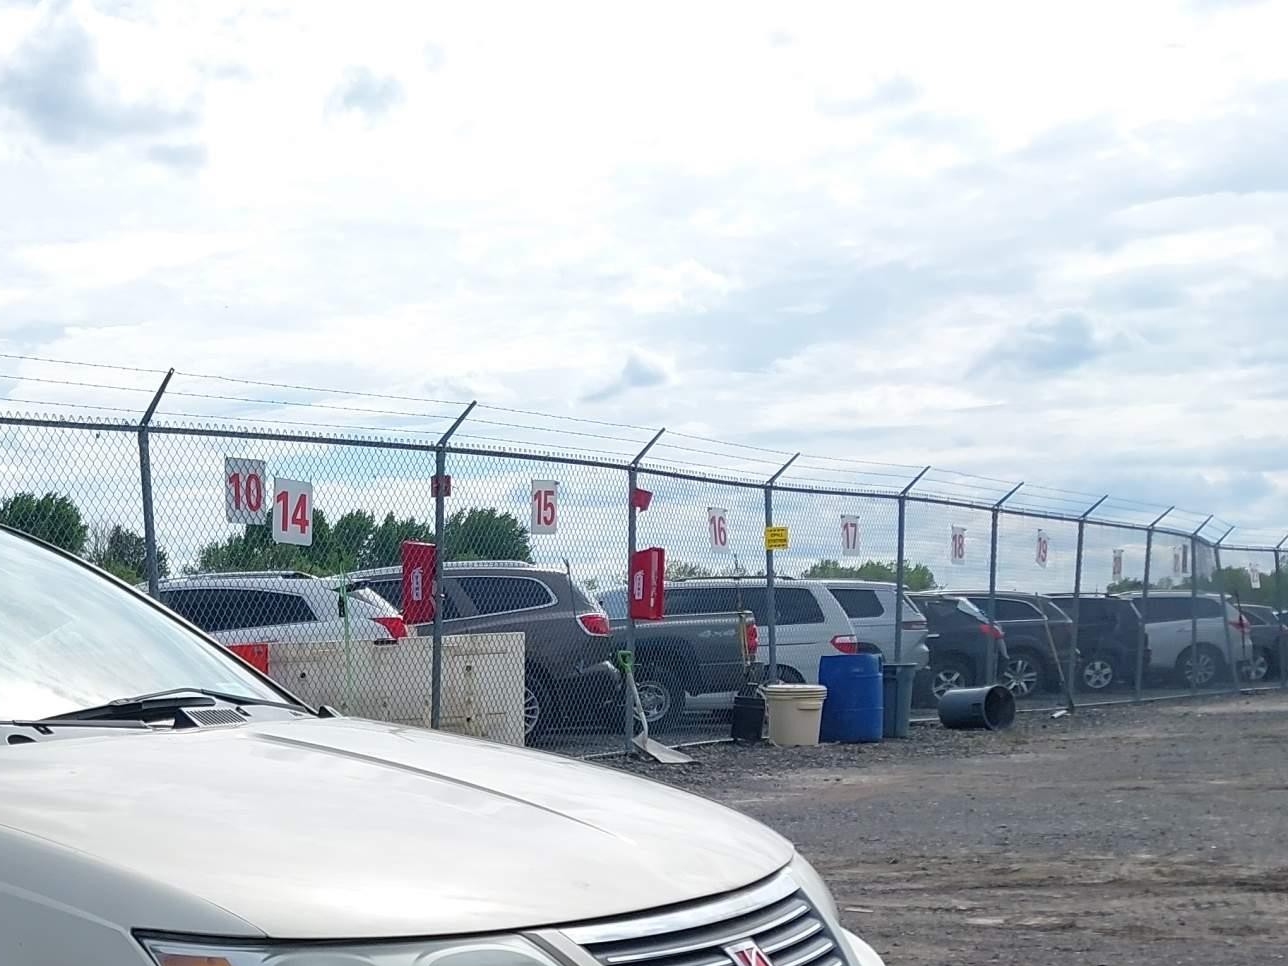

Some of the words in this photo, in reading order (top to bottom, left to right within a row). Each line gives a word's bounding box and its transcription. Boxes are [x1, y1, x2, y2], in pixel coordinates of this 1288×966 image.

[229, 472, 263, 513] 10
[533, 489, 555, 526] 15
[276, 491, 310, 535] 14
[710, 515, 727, 547] 16
[843, 522, 858, 550] 17
[951, 534, 964, 560] 18
[1038, 536, 1048, 563] 19
